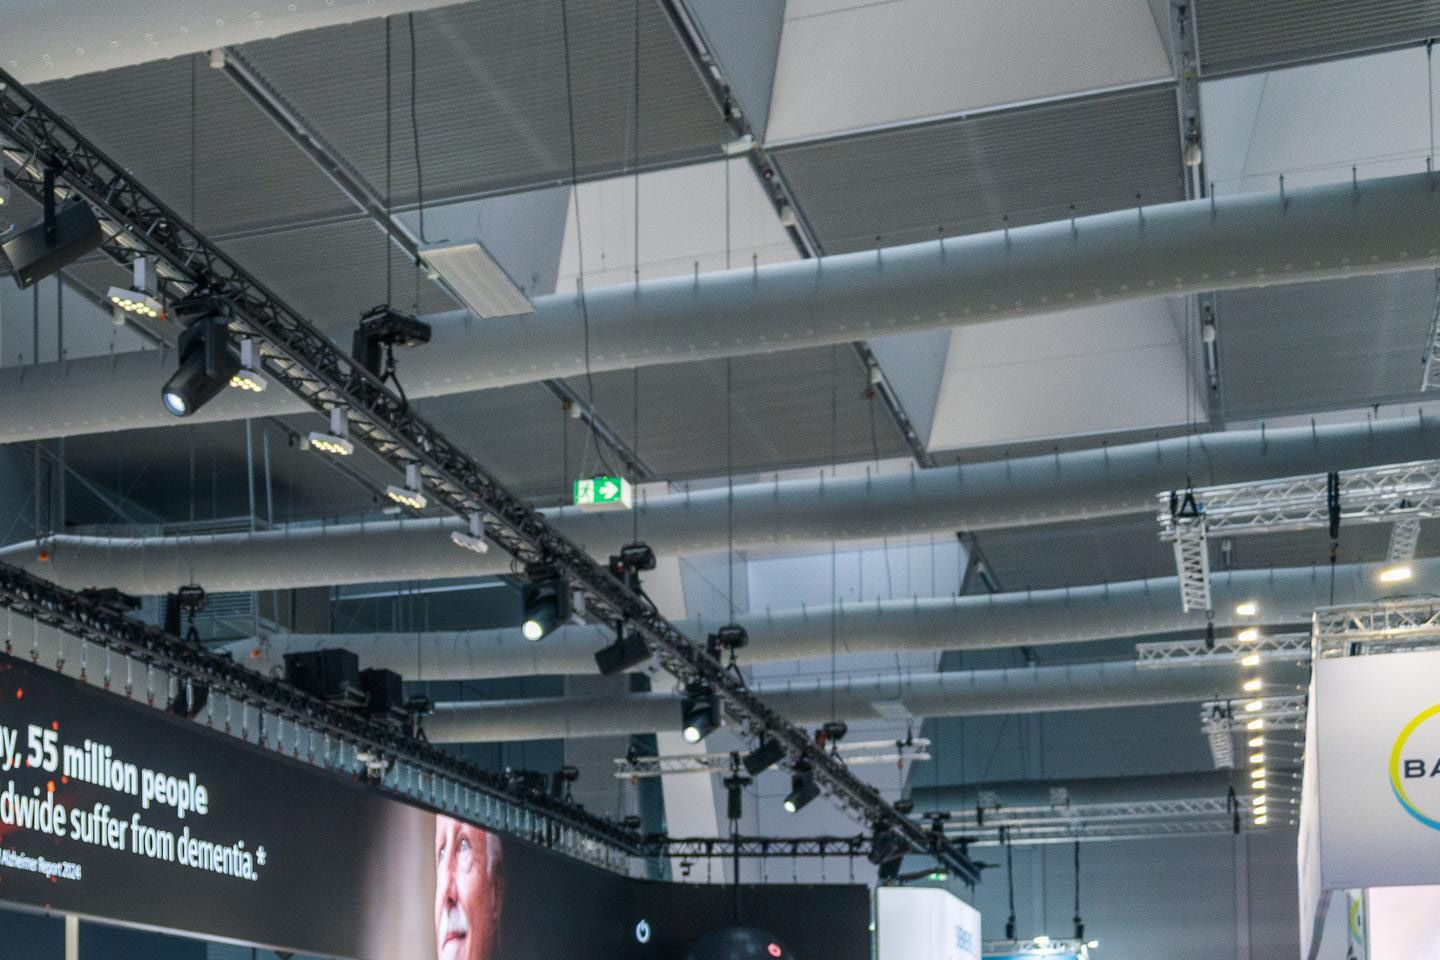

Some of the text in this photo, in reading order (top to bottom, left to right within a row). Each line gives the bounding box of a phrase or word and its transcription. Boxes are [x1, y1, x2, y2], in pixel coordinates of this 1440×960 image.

[27, 723, 59, 773] 55
[63, 739, 138, 796] million
[142, 772, 209, 819] people
[70, 802, 128, 851] suffer
[130, 813, 176, 862] from
[38, 856, 62, 878] Report
